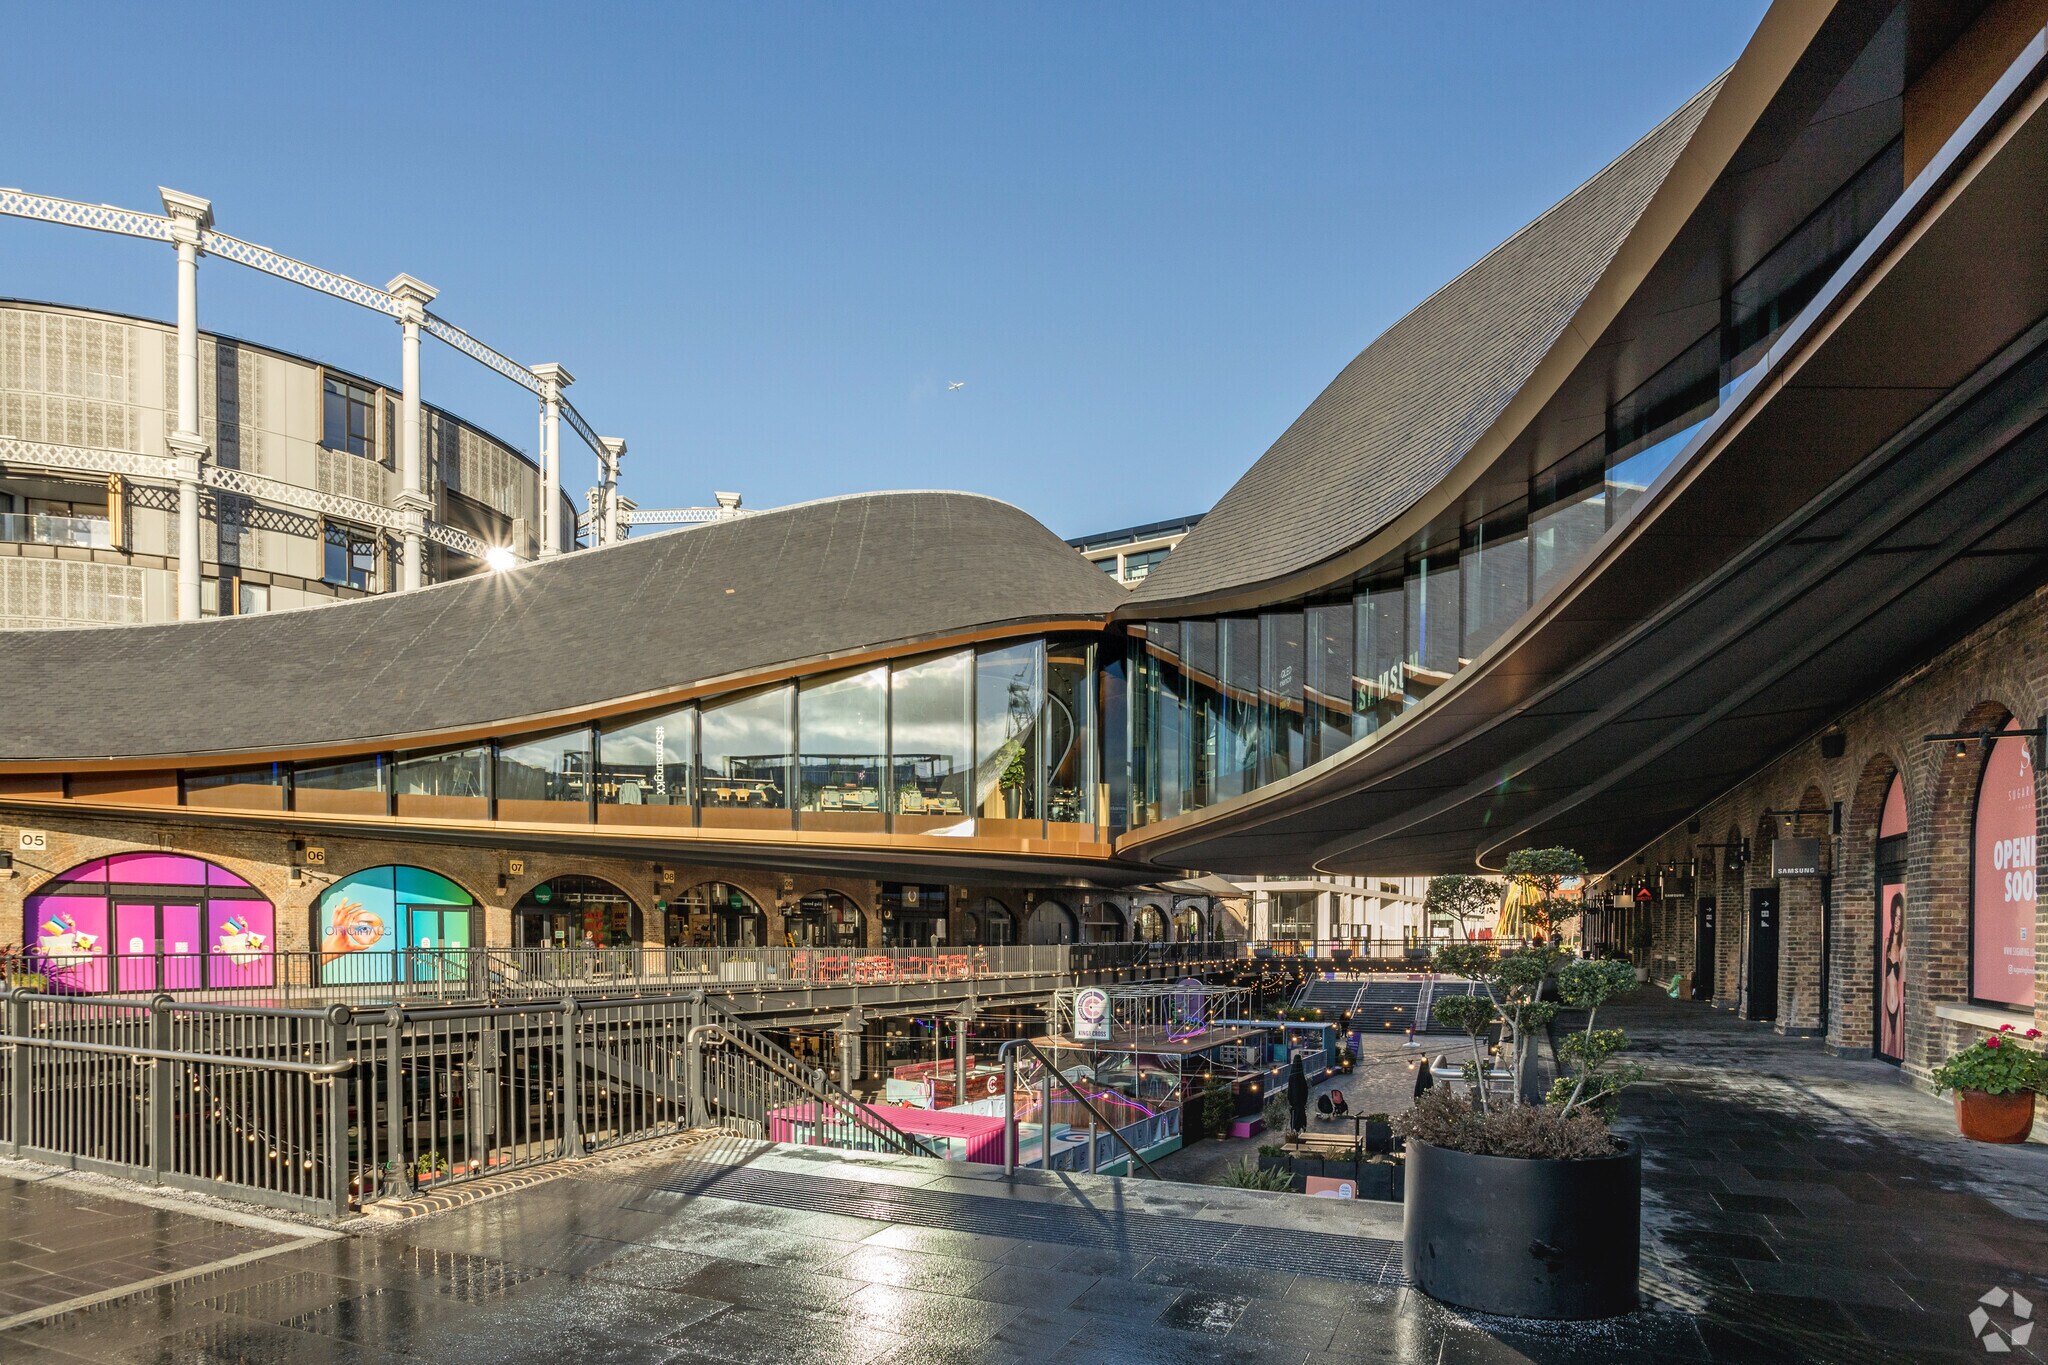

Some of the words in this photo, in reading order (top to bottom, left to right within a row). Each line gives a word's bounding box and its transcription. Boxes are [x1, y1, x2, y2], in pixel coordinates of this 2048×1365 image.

[22, 834, 44, 847] 05
[307, 850, 324, 861] 06
[1993, 835, 2036, 871] OPENI
[511, 863, 523, 872] 07
[1777, 867, 1815, 875] SAMSUNG
[664, 872, 674, 881] 08
[784, 880, 793, 888] 09
[2004, 869, 2038, 902] SOO
